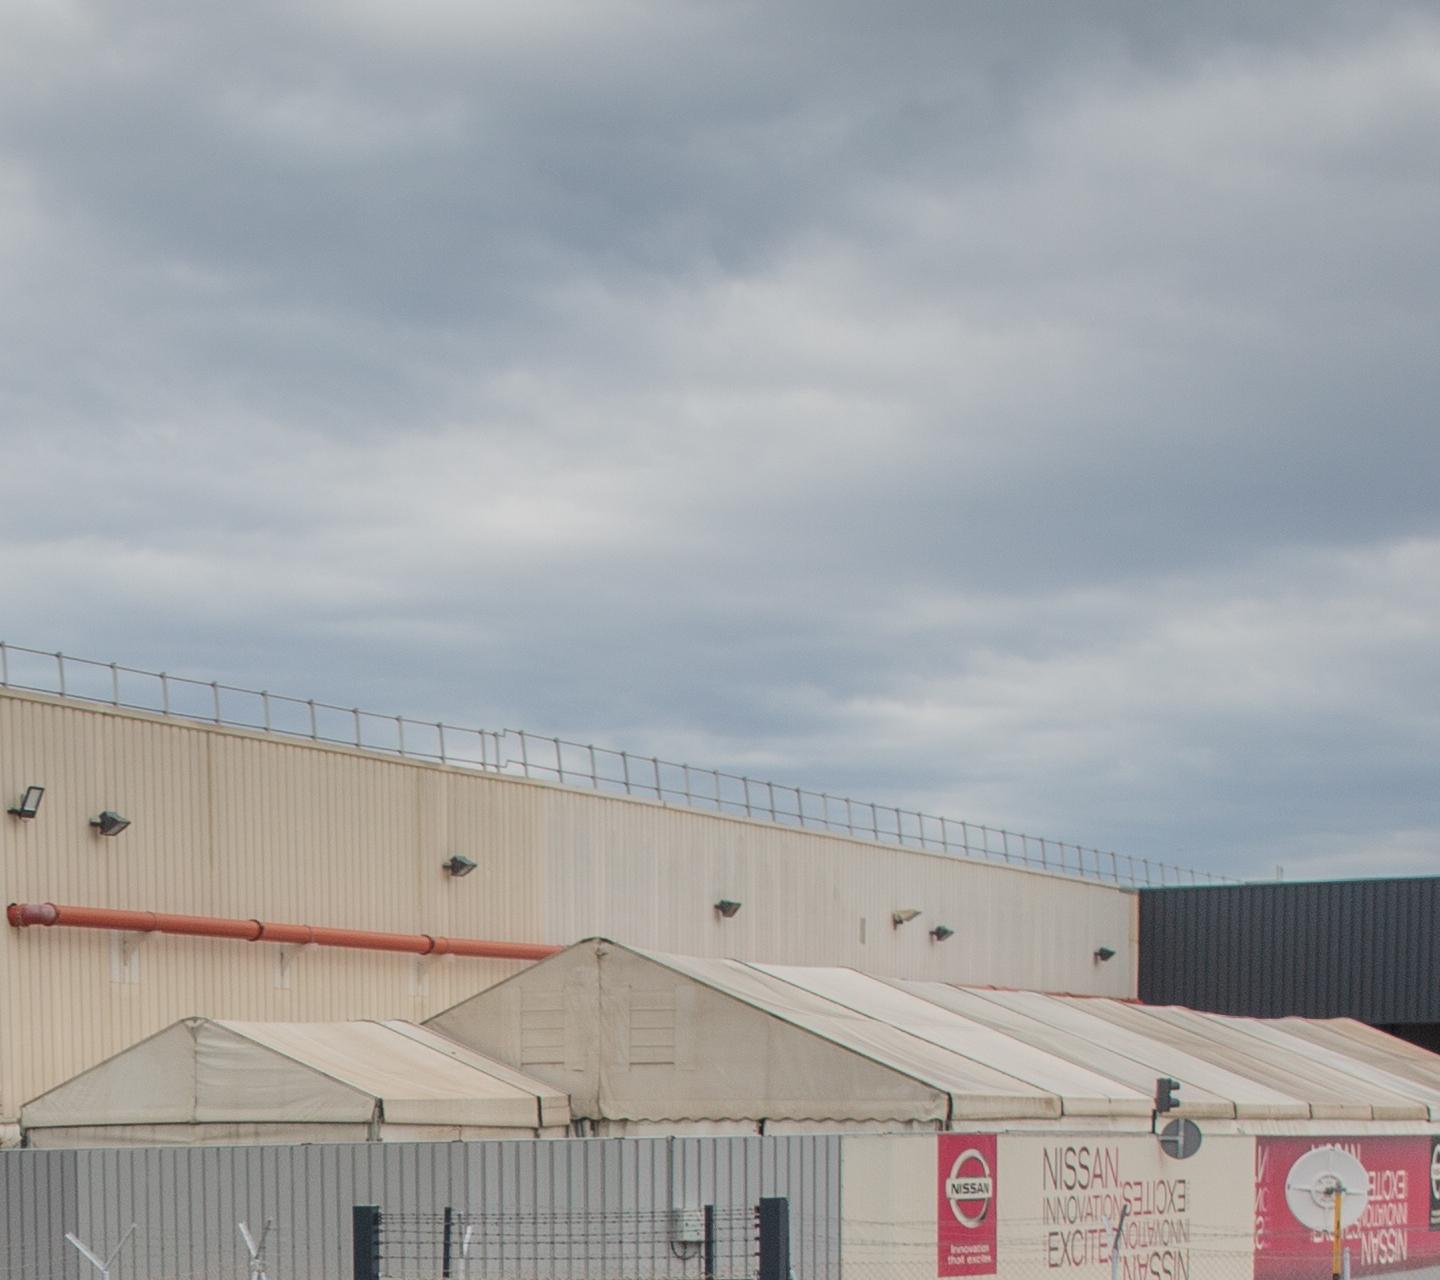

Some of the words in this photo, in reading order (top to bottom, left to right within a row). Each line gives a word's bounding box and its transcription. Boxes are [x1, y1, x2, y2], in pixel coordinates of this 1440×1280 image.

[1043, 1146, 1119, 1190] NISSAN
[951, 1183, 990, 1195] NISSAN
[948, 1254, 962, 1265] that
